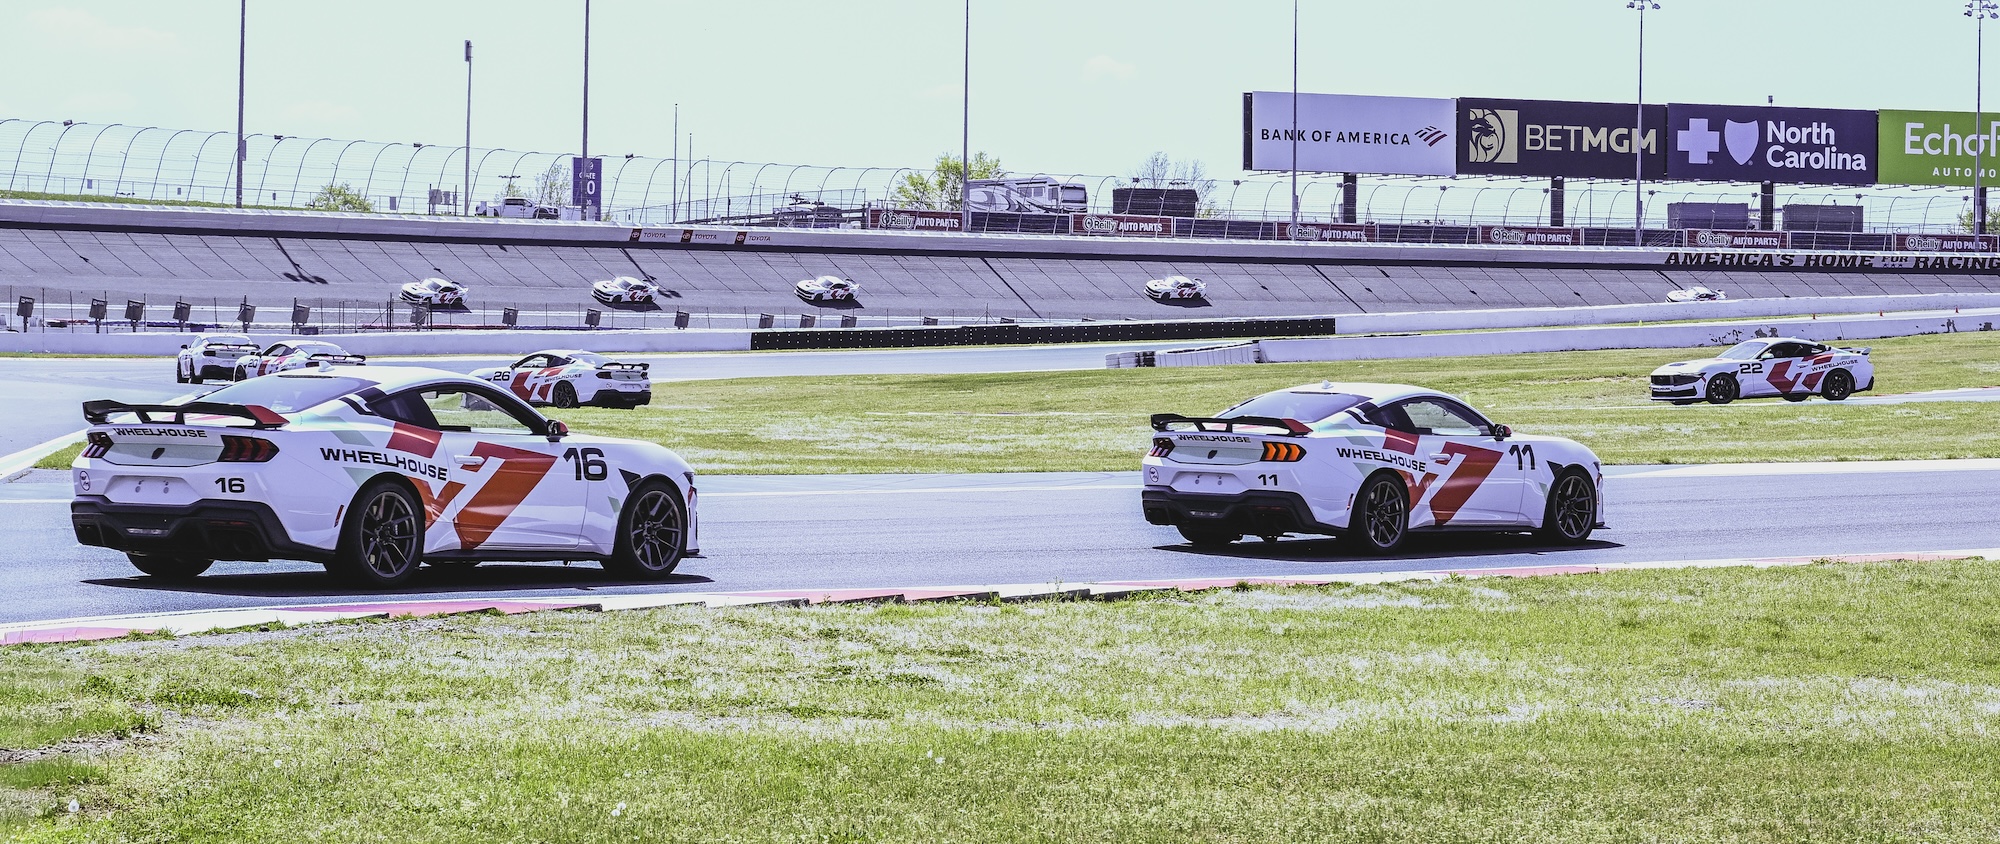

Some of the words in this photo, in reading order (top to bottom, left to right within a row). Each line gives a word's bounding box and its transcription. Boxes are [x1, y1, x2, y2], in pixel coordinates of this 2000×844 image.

[1261, 128, 1307, 142] BANK
[1311, 130, 1332, 143] OF
[1336, 131, 1411, 146] AMERICA
[1525, 124, 1657, 155] BETMGM
[1767, 120, 1835, 145] North
[1766, 144, 1867, 171] Carolina
[916, 217, 936, 227] AUTO
[935, 218, 959, 228] PARTS
[1084, 217, 1117, 233] O'Reilly
[1118, 221, 1139, 231] AUTO
[1139, 223, 1163, 232] PARTS
[1322, 230, 1342, 239] AUTO
[1342, 230, 1365, 240] PARTS
[1526, 233, 1547, 242] AUTO
[1547, 234, 1571, 243] PARTS
[1733, 236, 1753, 245] AUTO
[1754, 237, 1778, 246] PARTS
[1942, 240, 1963, 249] AUTO
[1664, 252, 1795, 267] AMERICA'S
[1804, 254, 1875, 267] HOME
[1912, 255, 2000, 270] RACING
[1739, 363, 1764, 375] 22
[1811, 359, 1859, 372] WHEELHOUSE
[493, 370, 511, 382] 26
[113, 427, 207, 438] WHEELHOUSE
[1176, 434, 1252, 444] WHEELHOUSE
[320, 447, 448, 481] WHEELHOUSE
[563, 447, 608, 481] 16
[1336, 447, 1426, 473] WHEELHOUSE
[1508, 444, 1536, 471] 11
[214, 477, 246, 493] 16
[1258, 474, 1278, 486] 11
